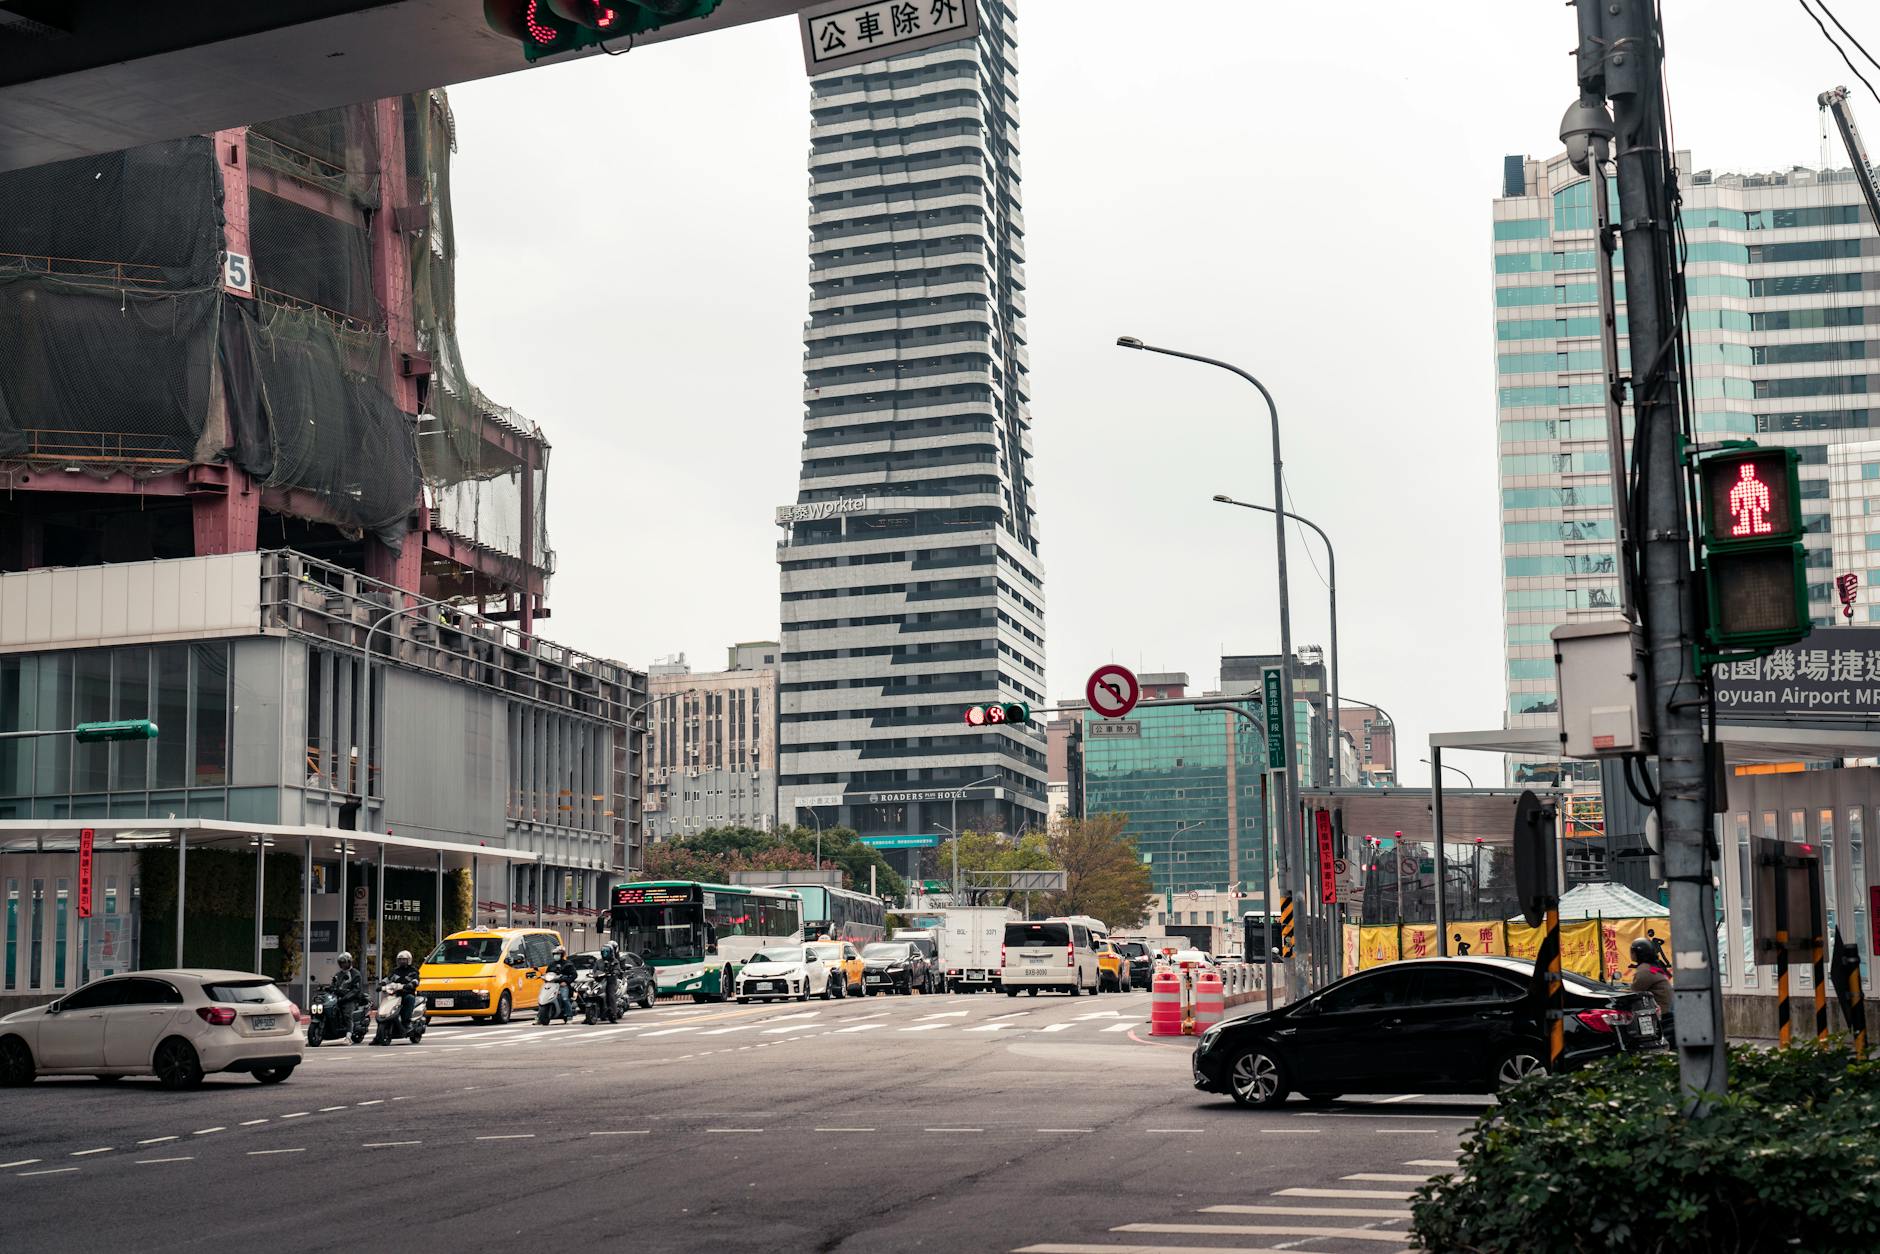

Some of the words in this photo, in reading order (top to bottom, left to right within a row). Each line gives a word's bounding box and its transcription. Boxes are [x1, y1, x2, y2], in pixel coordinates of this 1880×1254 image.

[820, 0, 962, 52] 公車除外
[230, 255, 246, 287] 5
[1269, 681, 1280, 731] 重慶北路一段
[1714, 689, 1779, 707] oyuan
[1781, 687, 1850, 707] Airport
[990, 707, 1005, 722] 54
[1095, 726, 1134, 734] 公車除外
[881, 792, 923, 802] ROADERS
[938, 791, 967, 799] HOTEL
[82, 832, 91, 904] 自行車請下車牽引
[1479, 928, 1493, 954] 施工
